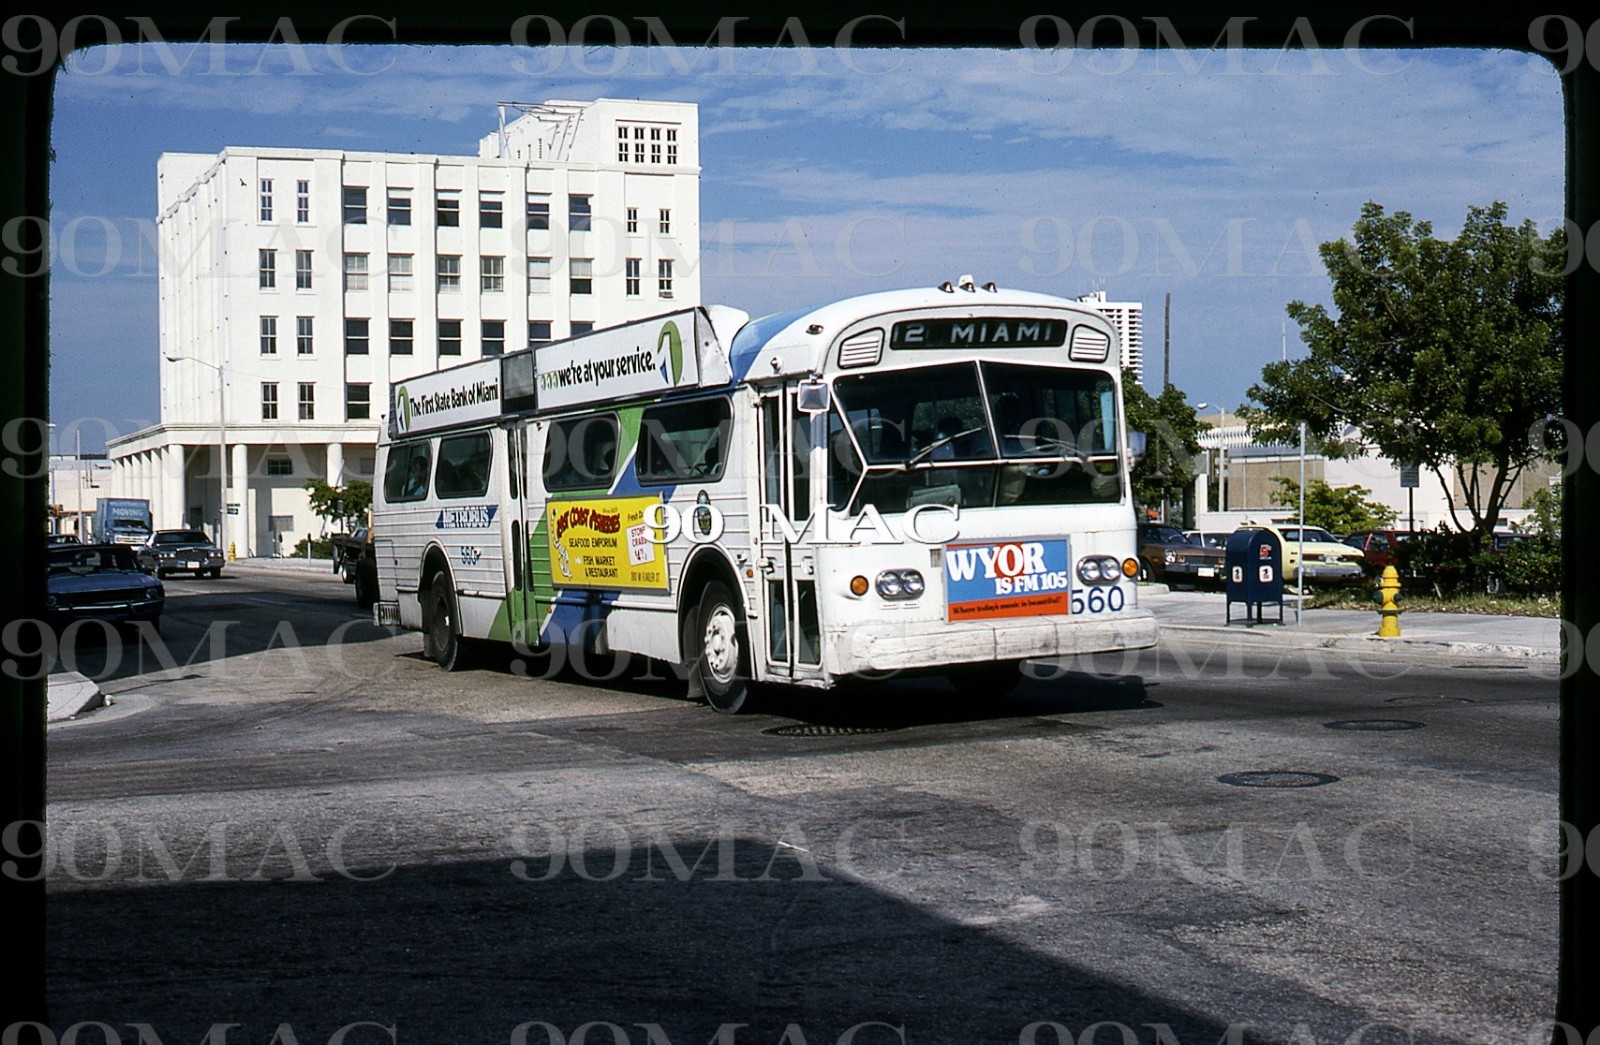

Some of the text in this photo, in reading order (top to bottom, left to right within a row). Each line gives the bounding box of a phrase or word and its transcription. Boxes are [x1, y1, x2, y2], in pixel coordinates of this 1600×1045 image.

[951, 322, 1051, 343] MIAMI
[558, 346, 656, 387] we're at your service.
[410, 377, 499, 417] The First State Bank of Miami
[112, 508, 144, 516] MOVING
[443, 506, 489, 528] METROBUS
[570, 506, 590, 528] COAST
[569, 537, 617, 548] SEAFOOD EMPORIUM
[583, 555, 616, 566] FISH MARKET
[945, 542, 1047, 582] WYOR
[995, 571, 1068, 595] IS FM 105
[953, 606, 975, 615] Where
[1000, 602, 1019, 610] music
[1021, 600, 1028, 608] is
[1072, 585, 1124, 615] 560
